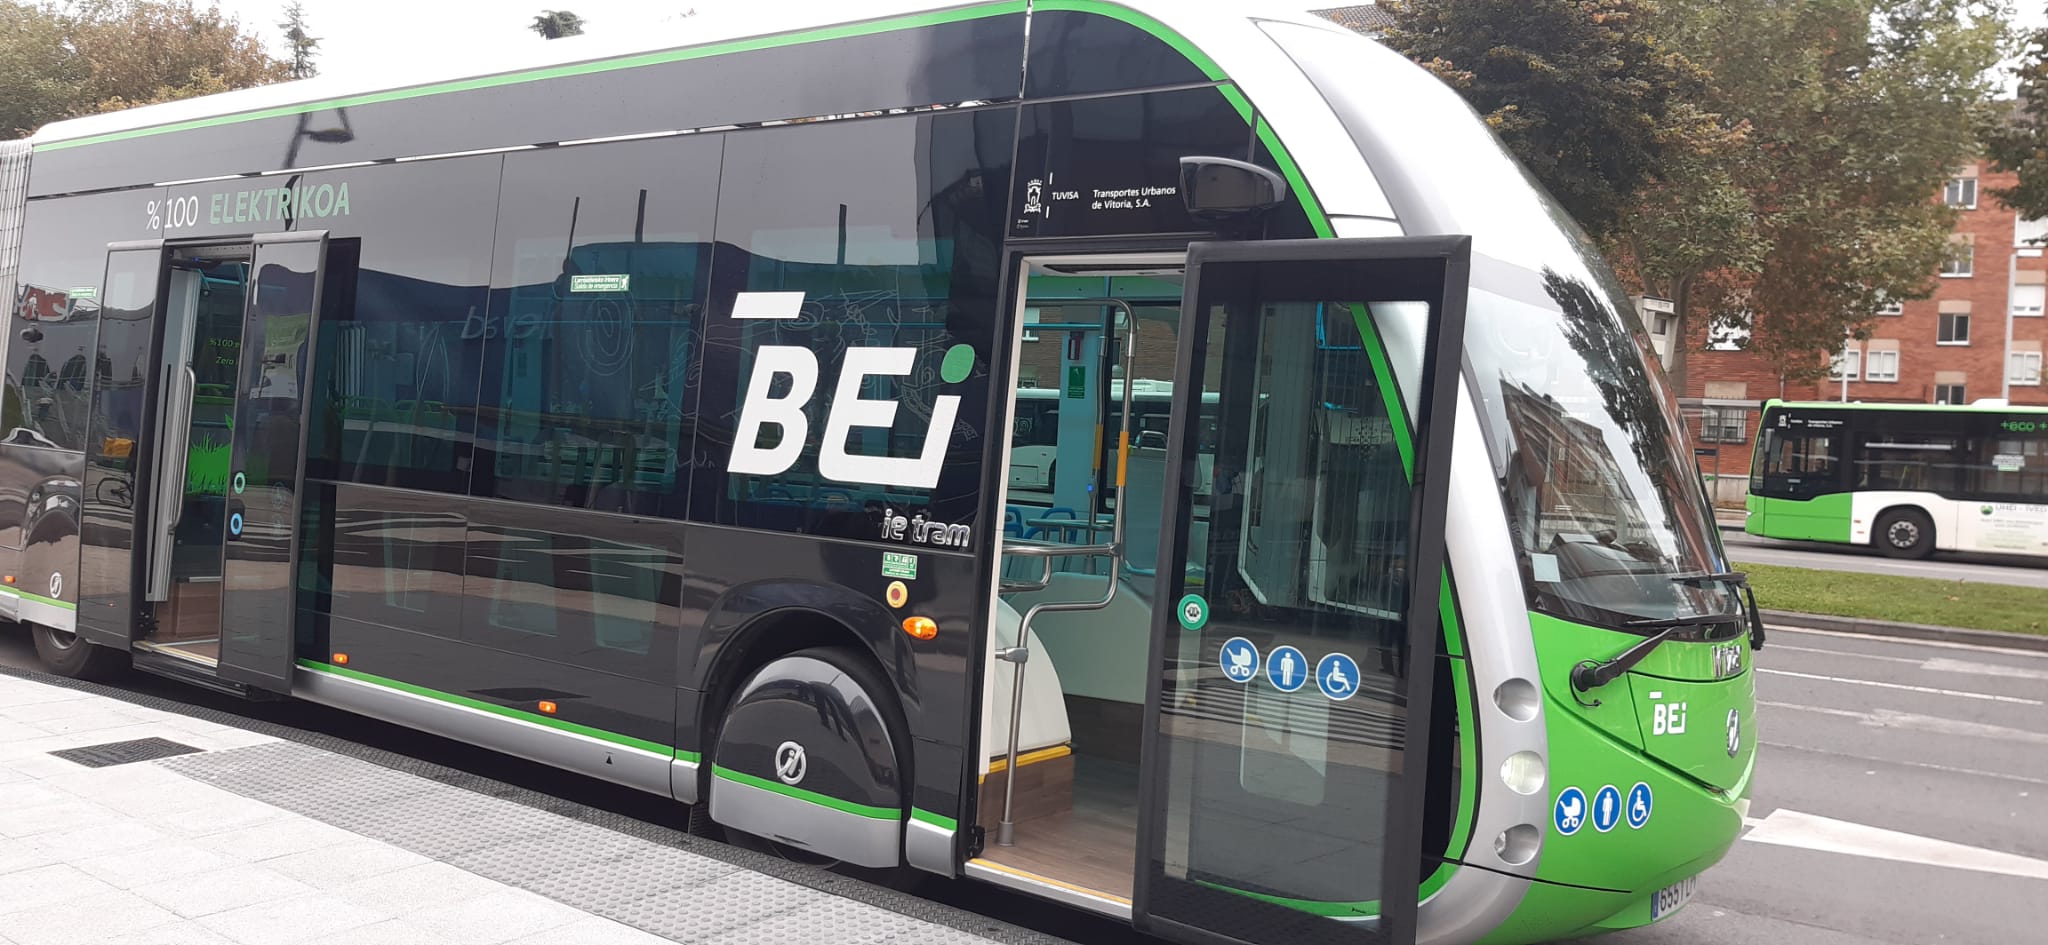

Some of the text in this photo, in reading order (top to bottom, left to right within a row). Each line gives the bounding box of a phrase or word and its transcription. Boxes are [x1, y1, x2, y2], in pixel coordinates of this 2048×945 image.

[1051, 191, 1079, 200] TUVISA
[1092, 186, 1176, 199] Transportes Urbanos
[210, 182, 350, 225] ELEKTRIKOA
[1091, 199, 1151, 210] de Vitoria, S.A.
[881, 508, 971, 548] ie tram
